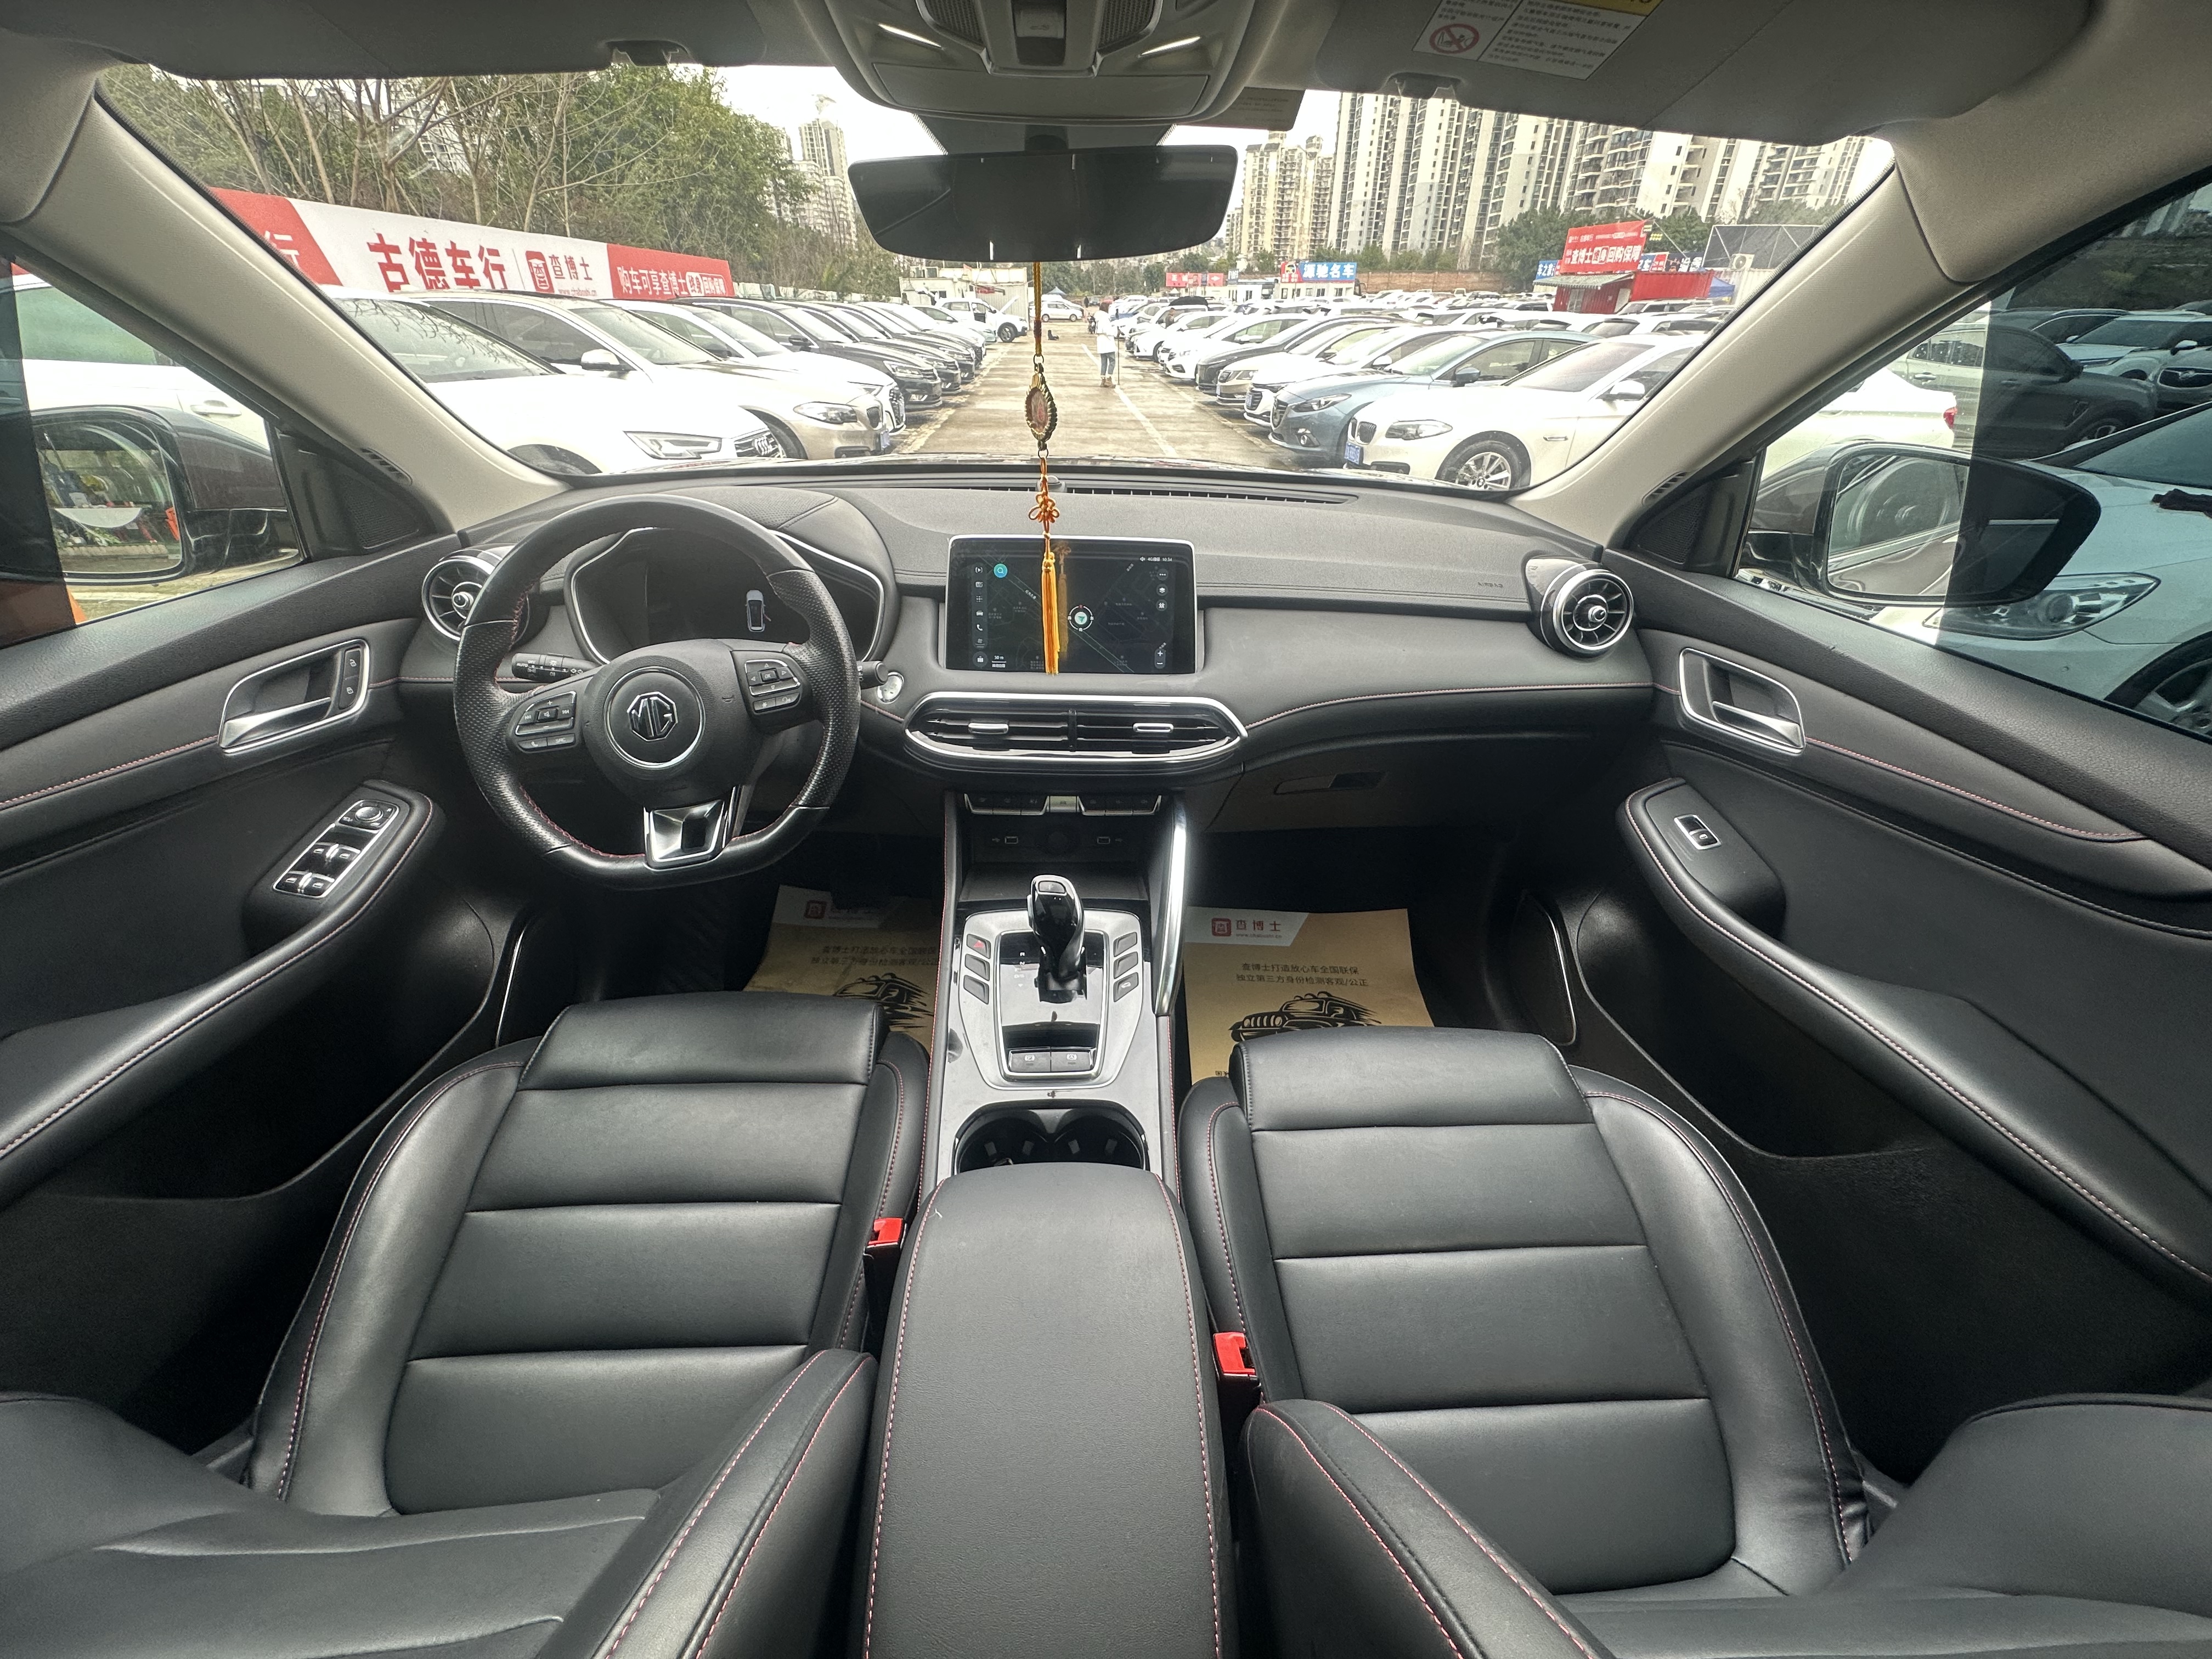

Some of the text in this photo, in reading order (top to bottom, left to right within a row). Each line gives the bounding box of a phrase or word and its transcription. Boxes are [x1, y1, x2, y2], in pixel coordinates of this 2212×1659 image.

[366, 232, 509, 292] 古德车行
[549, 254, 593, 281] 查博士
[631, 696, 673, 737] MG
